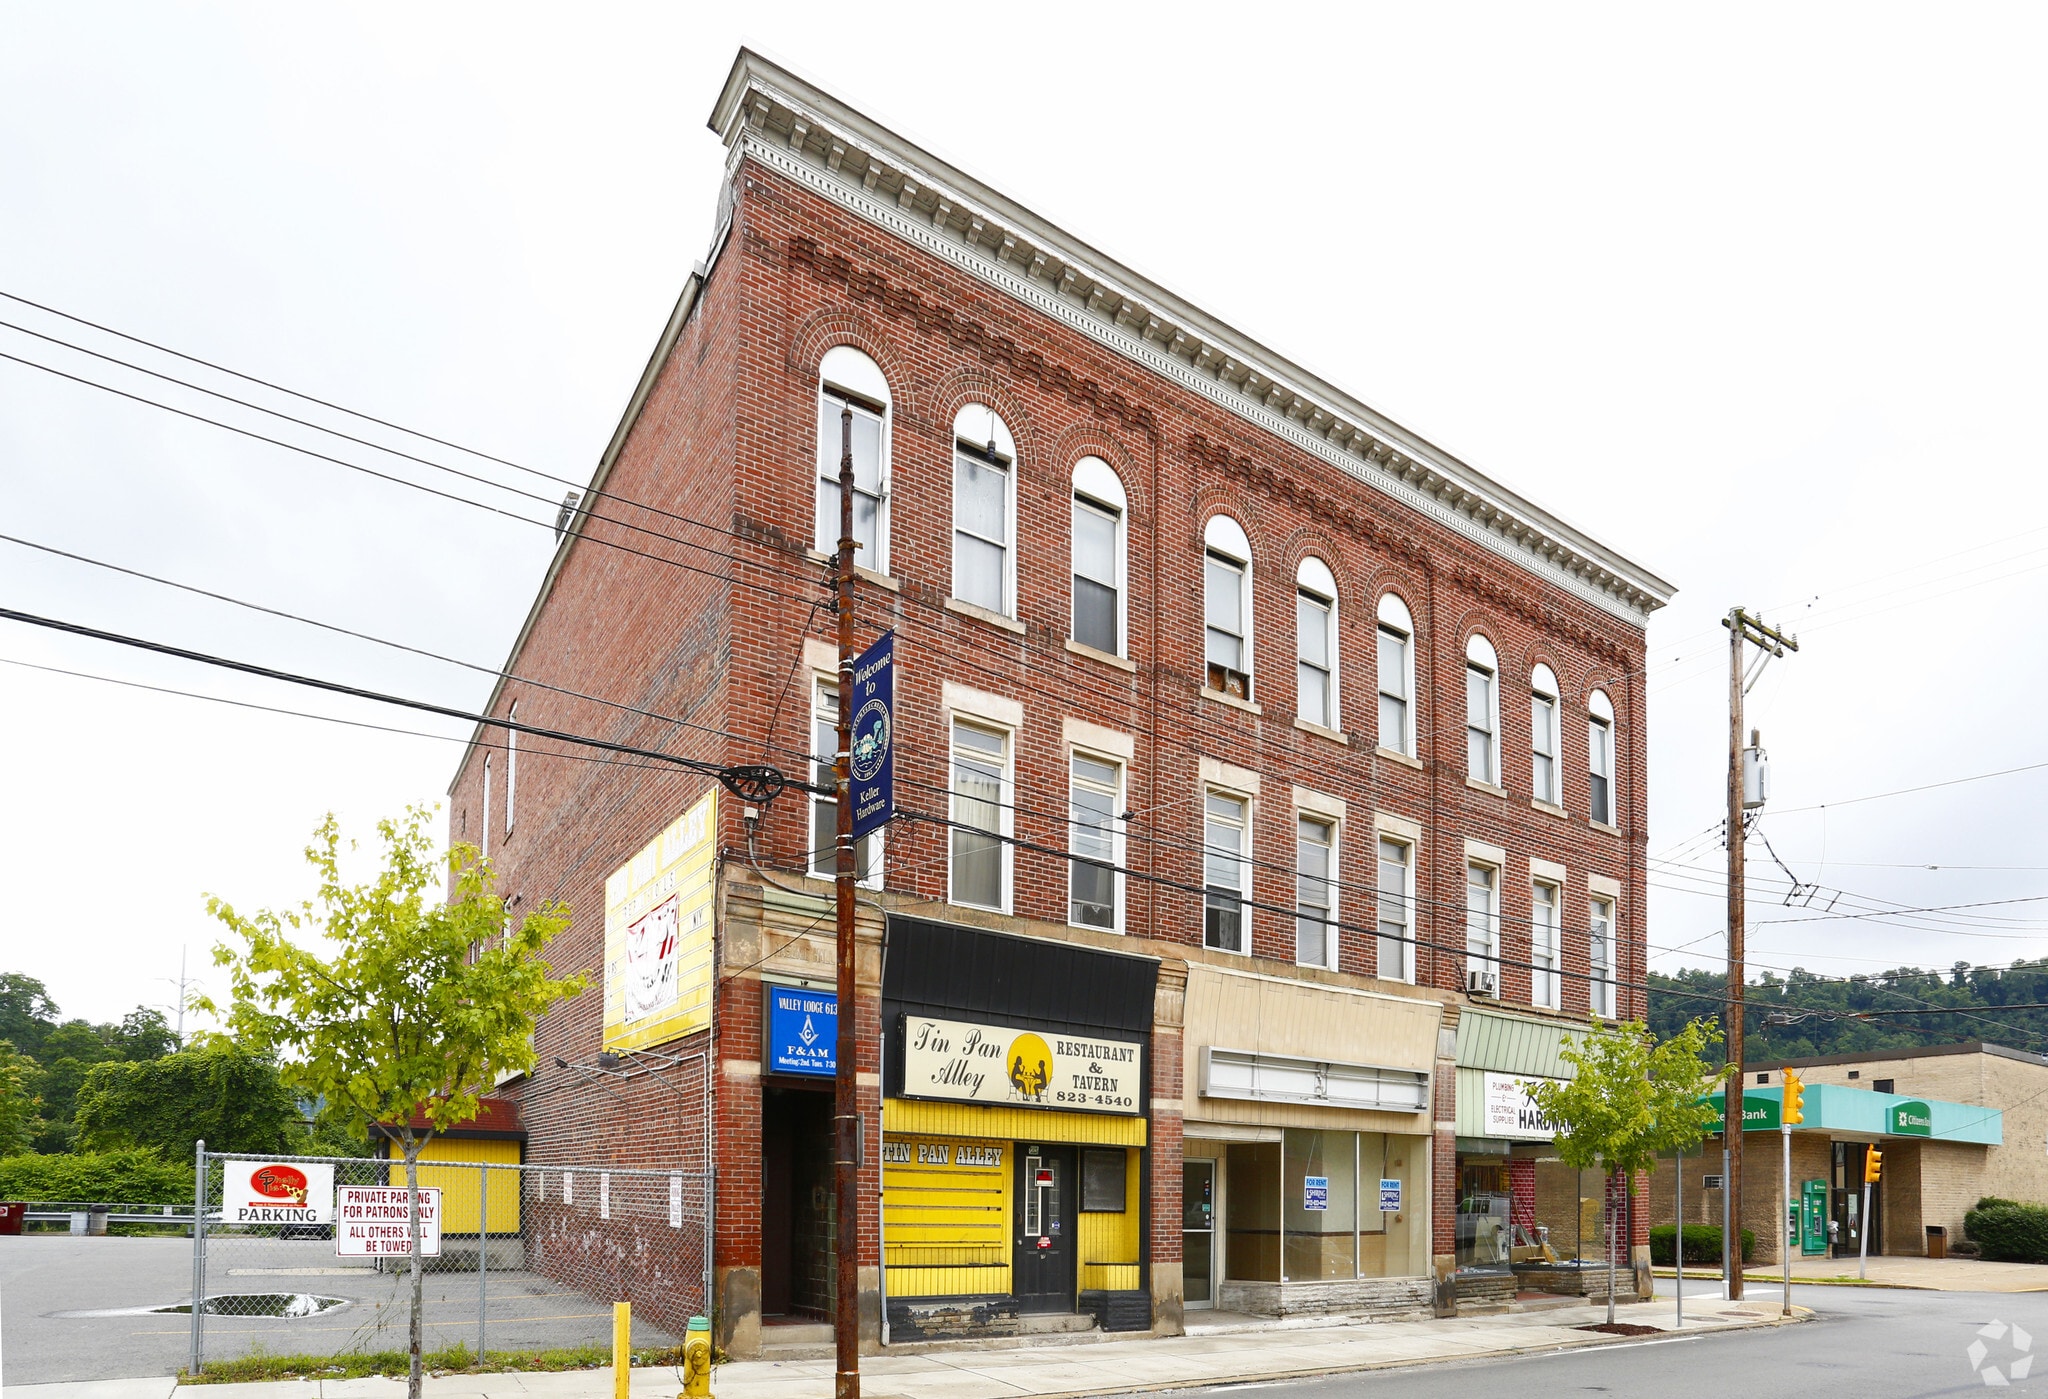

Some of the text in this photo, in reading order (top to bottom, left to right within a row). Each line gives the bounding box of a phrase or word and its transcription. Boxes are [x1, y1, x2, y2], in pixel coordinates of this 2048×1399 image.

[855, 652, 891, 686] Welcome
[865, 681, 876, 697] to
[860, 787, 880, 804] Keller
[856, 799, 886, 821] Hardware
[778, 997, 838, 1016] VALLEY LODGE 613
[913, 1022, 1002, 1059] Tin Pan
[787, 1045, 829, 1058] F&AM
[1056, 1040, 1135, 1063] RESTAURANT
[1088, 1061, 1104, 1075] &
[930, 1058, 986, 1097] Alley
[1072, 1074, 1119, 1093] TAVERN
[1492, 1081, 1515, 1093] PLUMBING
[1056, 1091, 1133, 1107] 823-4540
[1490, 1104, 1516, 1115] ELECTRICAL
[1741, 1108, 1768, 1120] Bank
[1492, 1115, 1515, 1125] SUPPLIES
[883, 1142, 1003, 1167] TIN PAN ALLEY
[1306, 1178, 1327, 1187] FOR RENT
[1381, 1180, 1400, 1190] FOR RENT
[347, 1191, 431, 1204] PRIVATE PARNG
[238, 1208, 317, 1222] PARKING
[343, 1205, 435, 1219] FOR PATRONS NLY
[349, 1226, 366, 1238] ALL
[368, 1226, 404, 1238] OTHERS
[365, 1240, 412, 1253] BE TOWED
